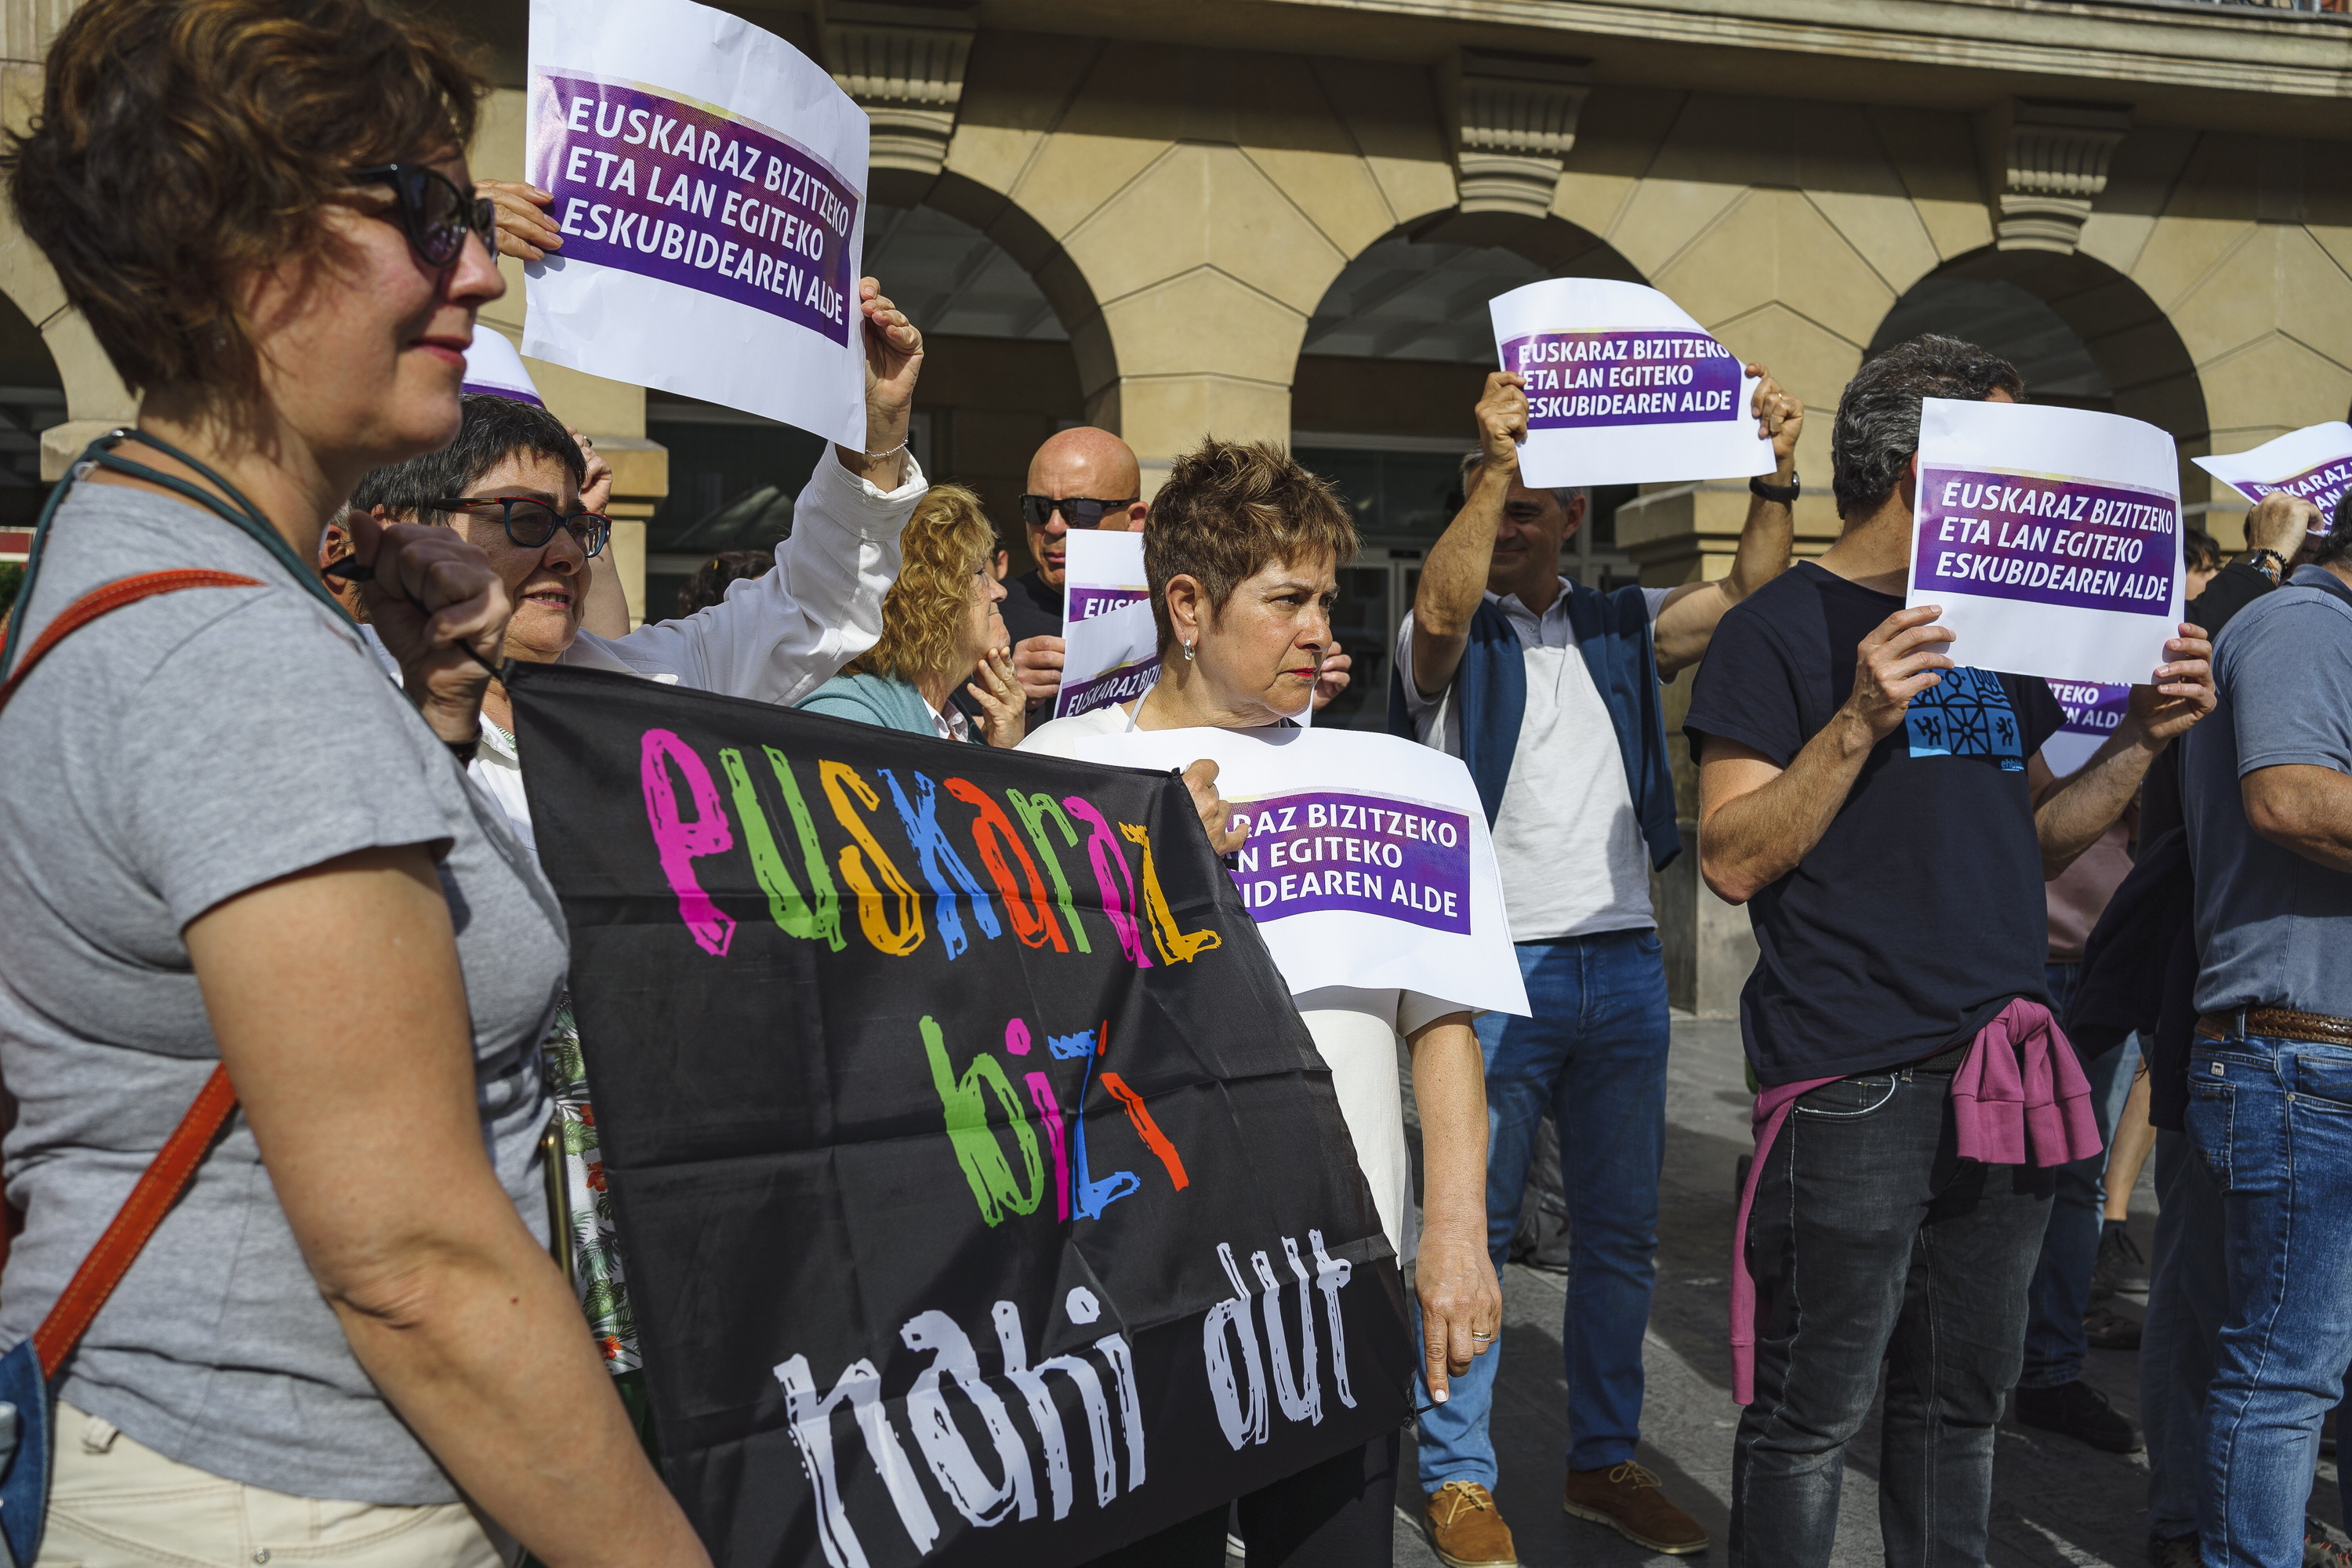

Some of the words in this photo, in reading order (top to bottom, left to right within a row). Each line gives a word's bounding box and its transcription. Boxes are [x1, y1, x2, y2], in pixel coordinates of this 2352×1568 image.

[568, 96, 762, 183] EUSKARAZ
[764, 156, 849, 238] BIZITZEKO
[565, 146, 636, 197] ETA
[646, 165, 717, 219] LAN
[720, 190, 823, 261] EGITEKO
[560, 197, 804, 302] ESKUBIDEAREN
[804, 275, 843, 325] ALDE
[1519, 340, 1628, 365] EUSKARAZ
[1633, 339, 1730, 360] BIZITZEKO
[1523, 369, 1559, 390] ETA
[1564, 368, 1604, 389] LAN
[1609, 365, 1693, 387] EGITEKO
[1527, 392, 1677, 418] ESKUBIDEAREN
[1680, 390, 1732, 412] ALDE
[1941, 482, 2089, 521] EUSKARAZ
[2092, 499, 2173, 535] BIZITZEKO
[1939, 517, 1991, 545] ETA
[1998, 523, 2051, 552] LAN
[2052, 530, 2143, 564] EGITEKO
[1936, 552, 2121, 597] ESKUBIDEAREN
[2119, 577, 2169, 602] ALDE
[1065, 673, 1141, 717] EUSKARAZ
[641, 727, 1223, 968] euskaraz
[1308, 804, 1457, 848] BIZITZEKO
[1270, 837, 1403, 868] EGITEKO
[1235, 870, 1382, 909] IDEAREN
[1390, 879, 1457, 918] ALDE
[920, 1015, 1189, 1228] bizi
[773, 1286, 1146, 1568] nahi
[1204, 1229, 1357, 1451] dut
